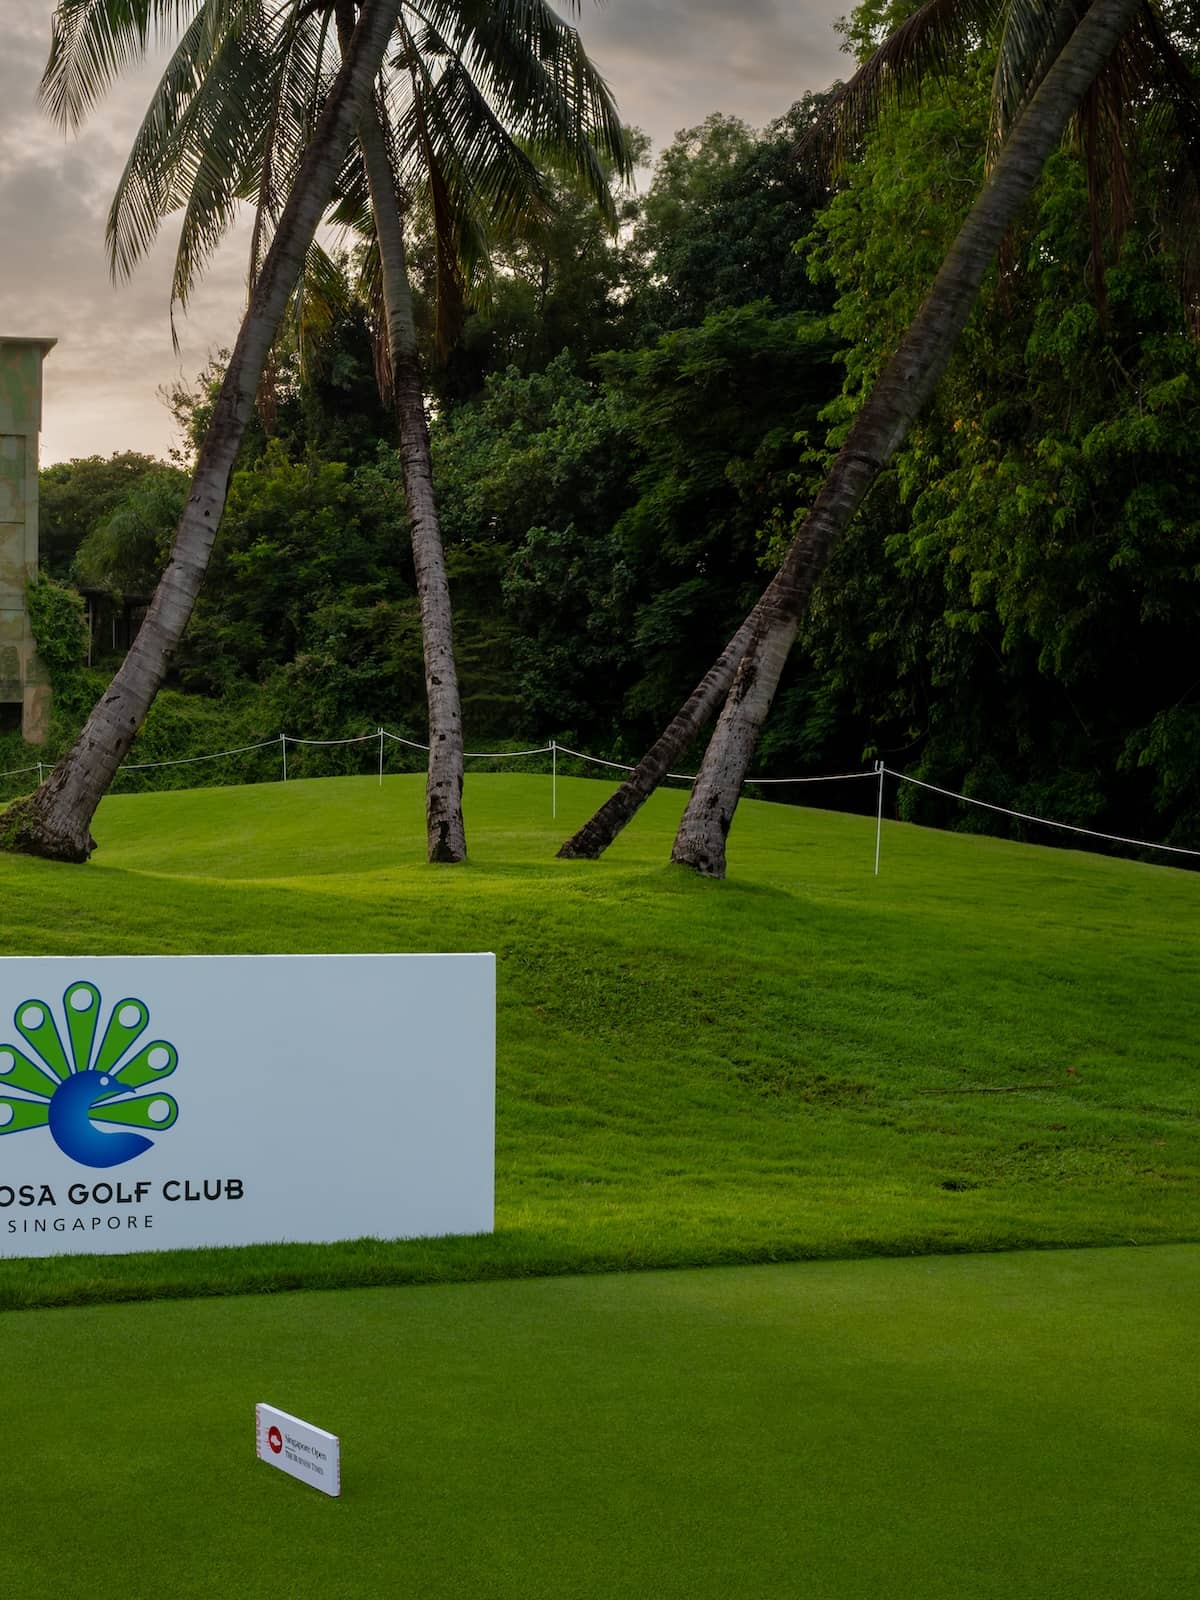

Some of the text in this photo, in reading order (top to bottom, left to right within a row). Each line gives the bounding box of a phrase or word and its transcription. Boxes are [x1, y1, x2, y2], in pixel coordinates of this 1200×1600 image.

[68, 1182, 152, 1205] GOLF
[162, 1178, 244, 1201] CLUB
[8, 1215, 154, 1233] SINGAPORE
